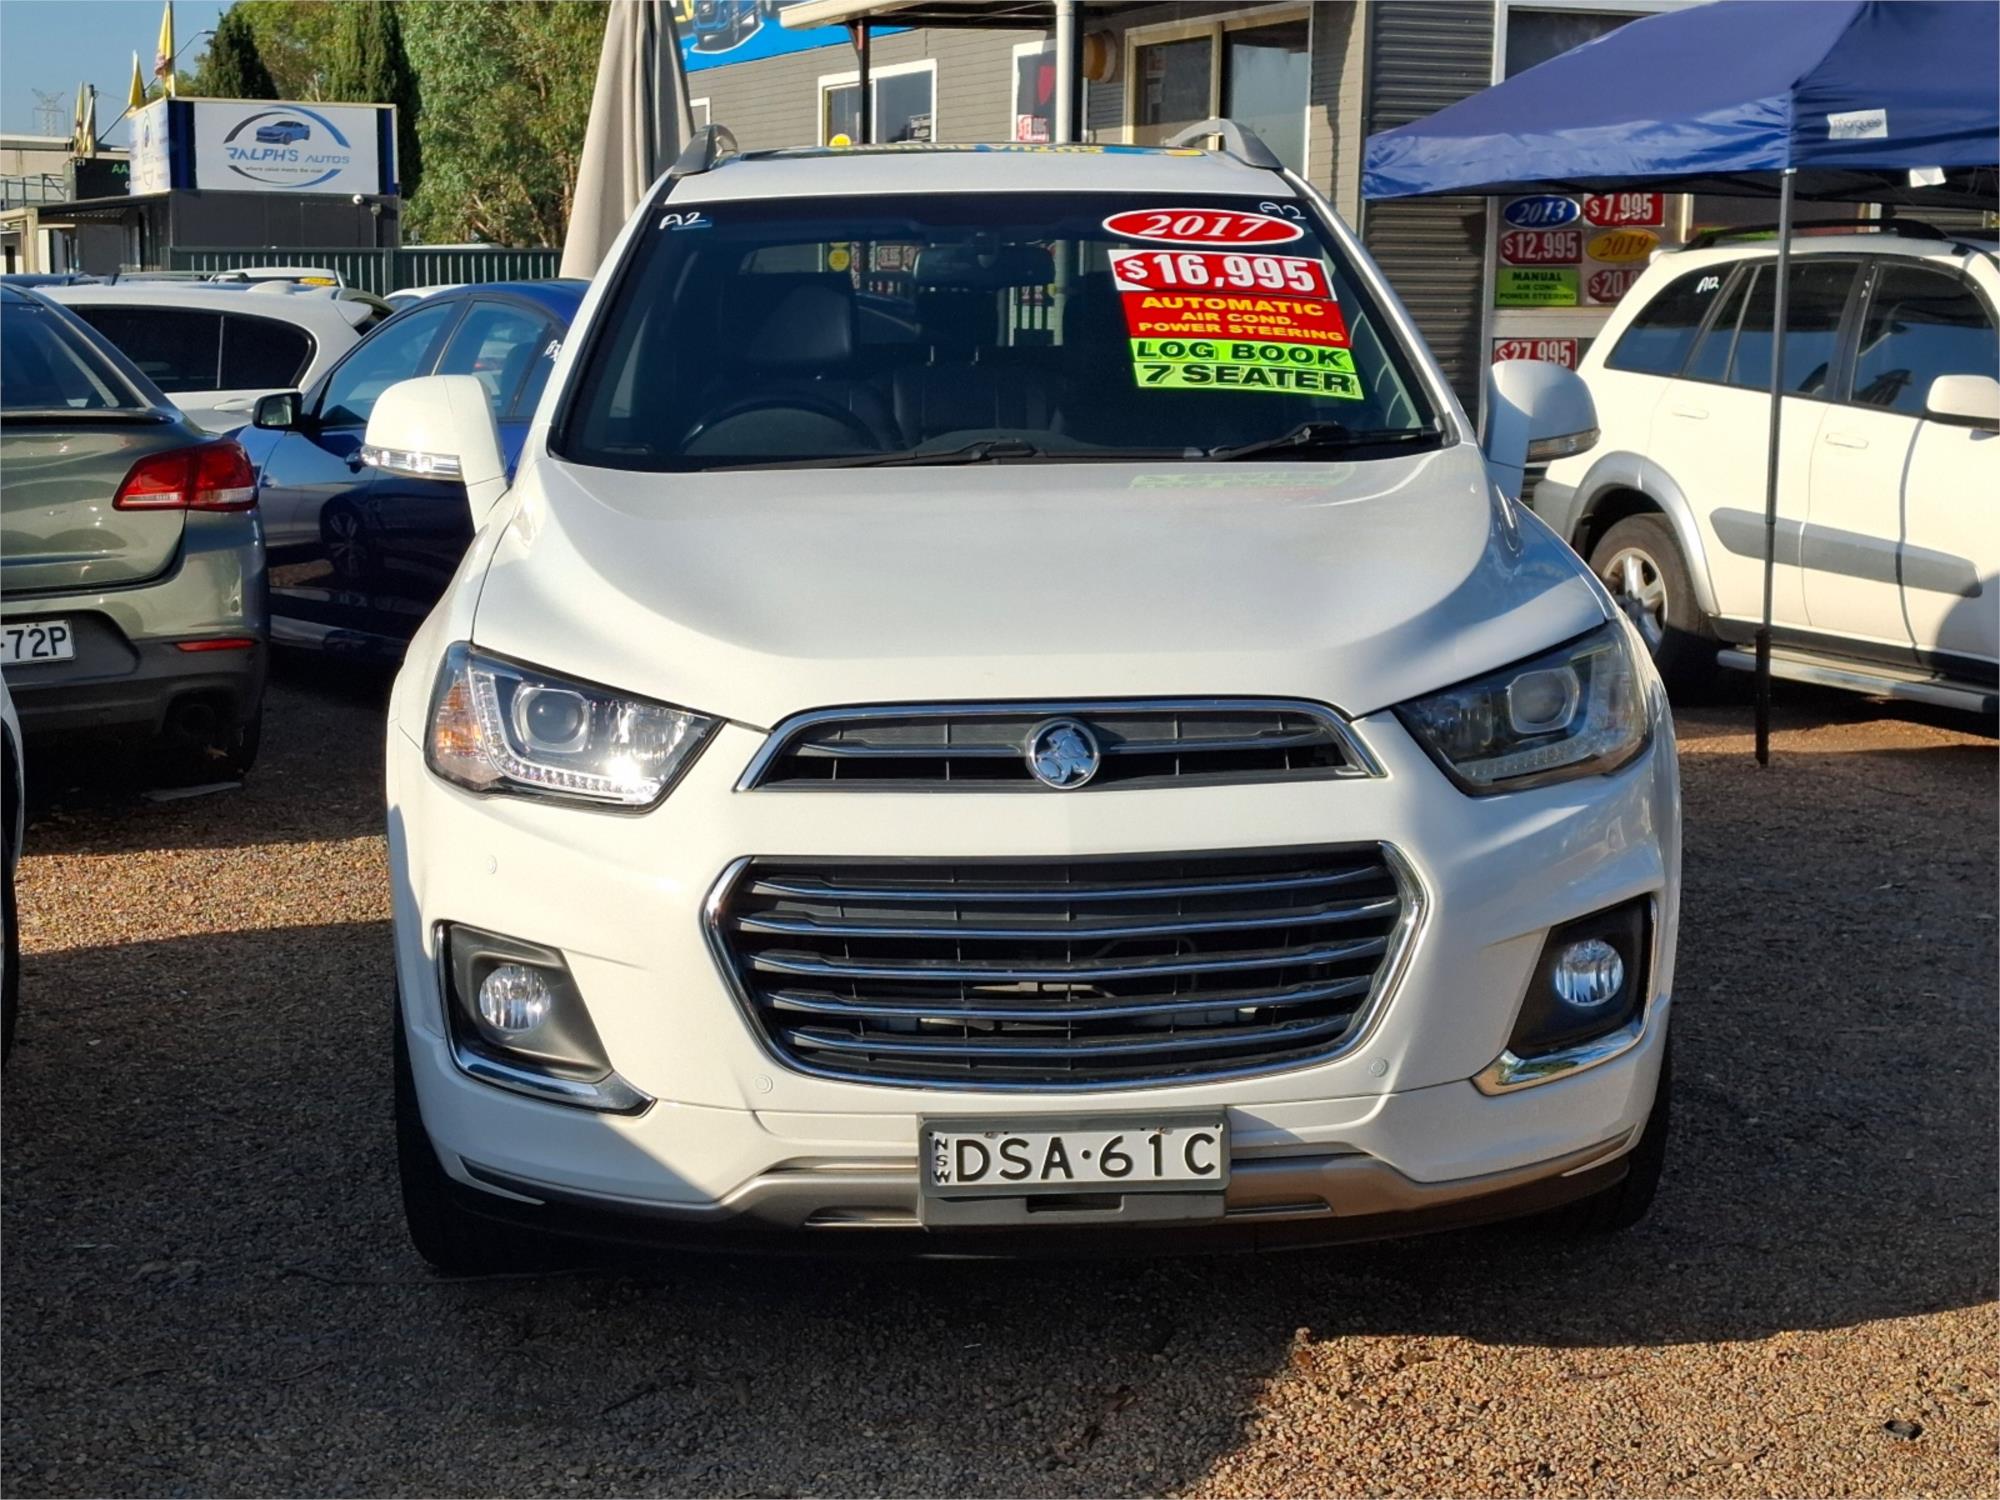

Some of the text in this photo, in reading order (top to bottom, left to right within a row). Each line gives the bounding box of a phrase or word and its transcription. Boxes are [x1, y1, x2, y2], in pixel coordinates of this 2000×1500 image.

[225, 147, 350, 164] RALPH'S AUTOS
[1259, 202, 1307, 219] A2
[1515, 200, 1568, 224] 2013
[1589, 192, 1654, 222] $7,995
[658, 211, 707, 230] A2
[1137, 214, 1270, 239] 2017
[1504, 232, 1578, 261] $12,995
[1599, 233, 1650, 258] 2019
[1123, 252, 1316, 292] $16,995
[1511, 271, 1563, 282] MANUAL
[1141, 296, 1325, 317] AUTOMATIC
[1500, 292, 1576, 300] POWER STEERING
[1180, 311, 1299, 327] AIR COND.
[1138, 322, 1344, 342] POWER STEERING
[1136, 341, 1348, 369] LOG BOOK
[1498, 340, 1572, 367] $27995
[1143, 364, 1357, 394] 7 SEATER
[934, 1138, 951, 1184] NSW
